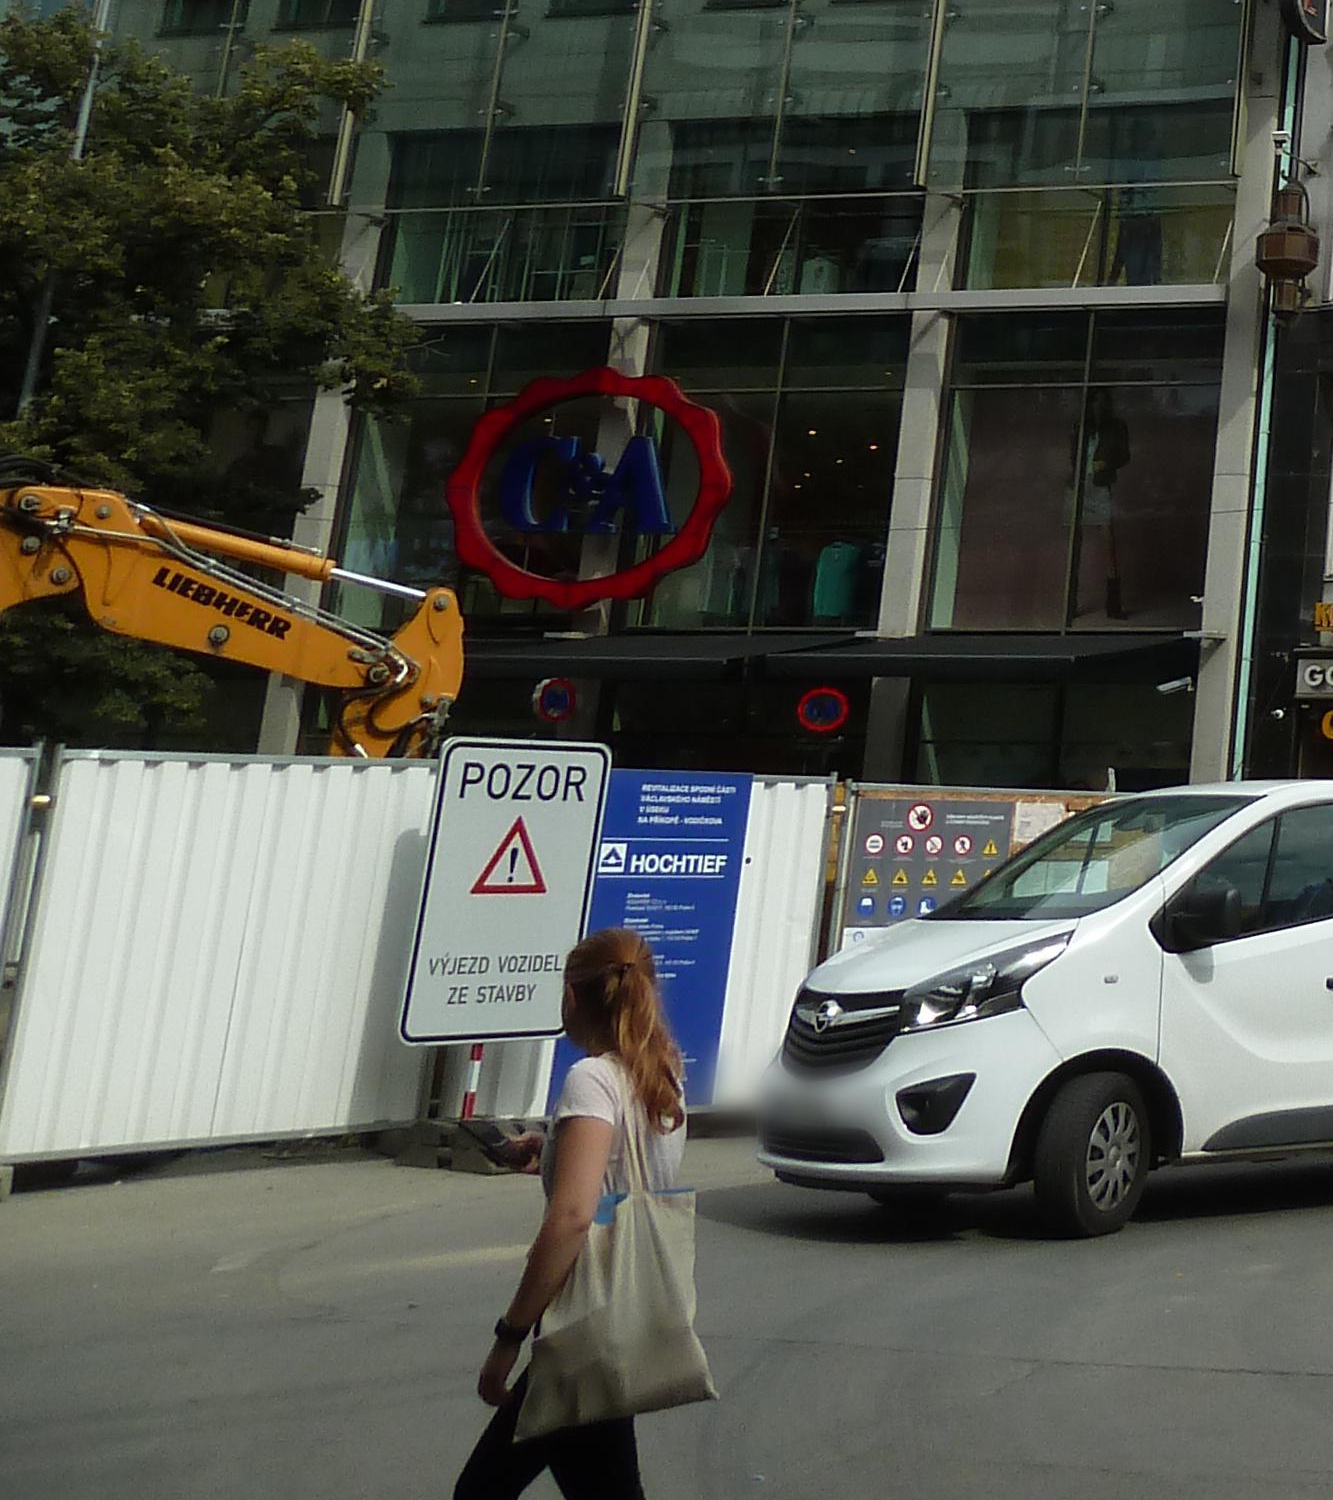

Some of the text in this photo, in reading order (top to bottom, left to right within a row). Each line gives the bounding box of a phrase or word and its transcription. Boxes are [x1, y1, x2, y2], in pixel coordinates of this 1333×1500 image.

[499, 435, 677, 534] C&A
[152, 566, 294, 641] LIEBHERR
[459, 762, 588, 802] POZOR
[630, 854, 728, 874] HOCHTIEF
[428, 952, 563, 978] VÝJEZD VOZIDEL
[447, 982, 537, 1005] ZE STAVBY
